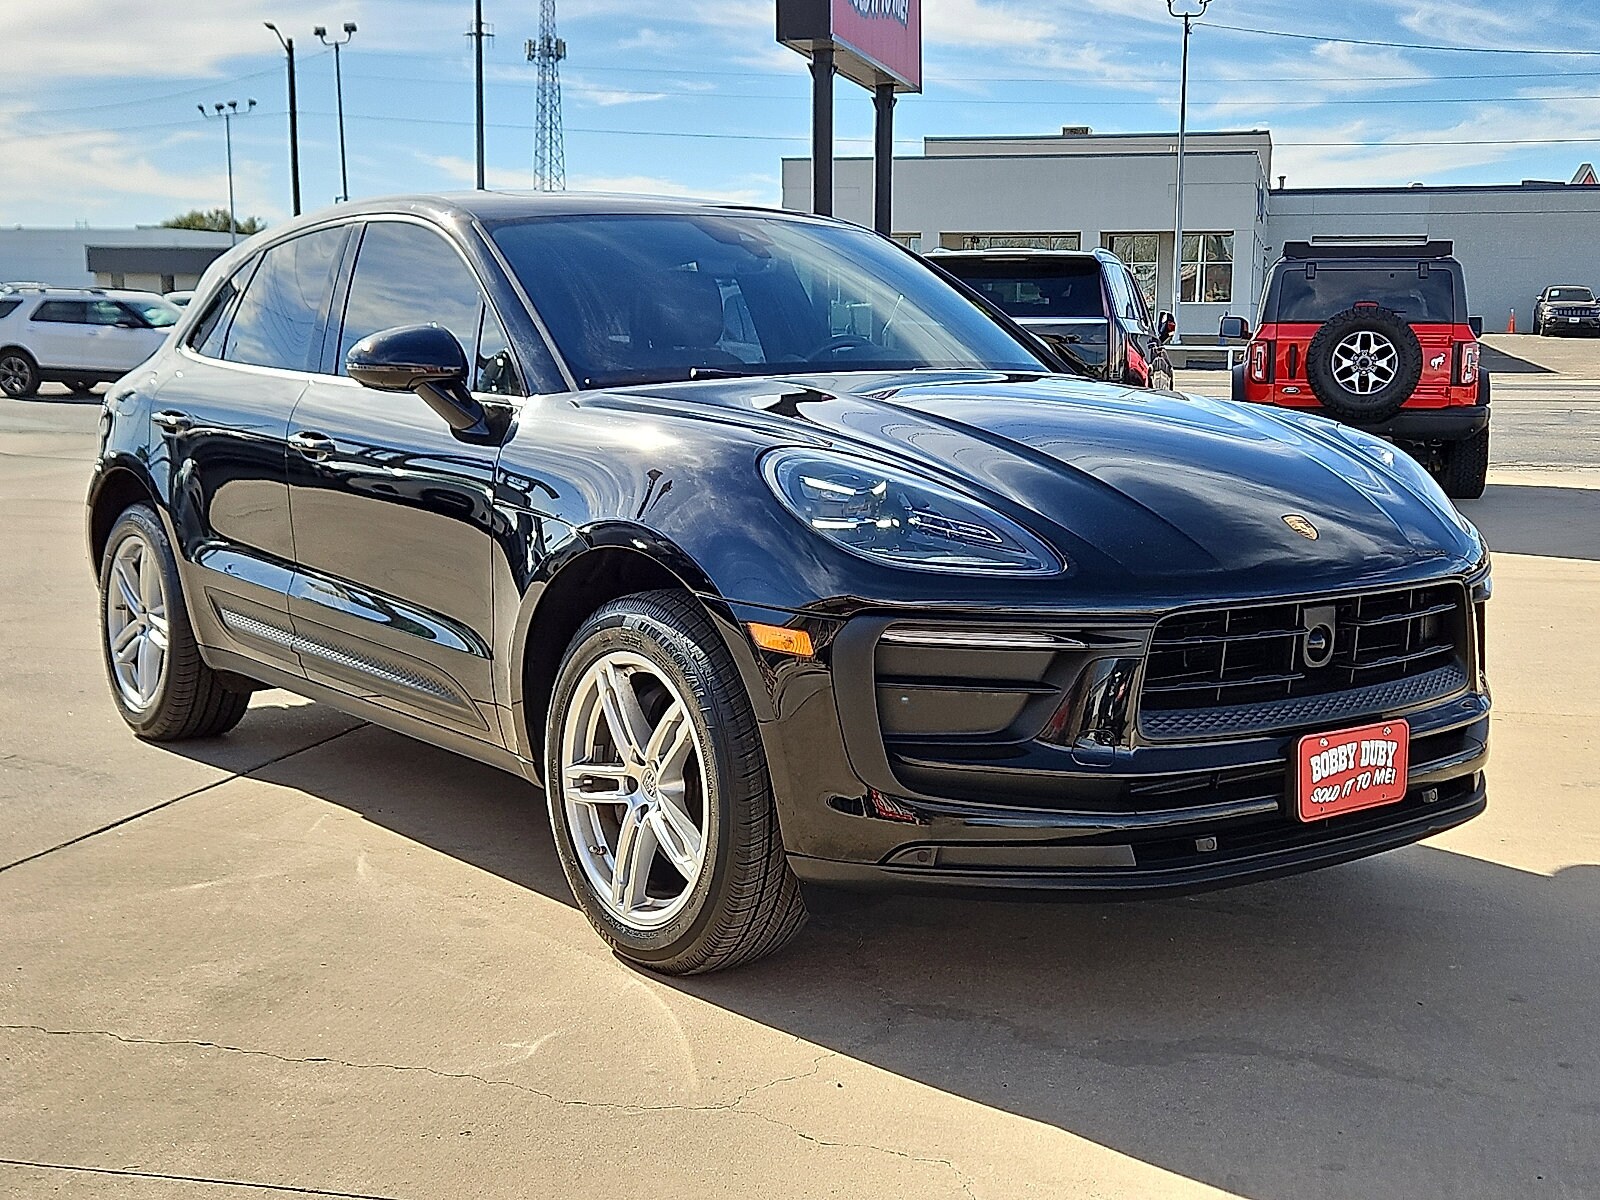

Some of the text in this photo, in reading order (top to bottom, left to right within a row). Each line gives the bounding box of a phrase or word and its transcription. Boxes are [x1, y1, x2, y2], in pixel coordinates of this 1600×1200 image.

[1310, 740, 1397, 783] BOBBY DUBY
[1311, 768, 1396, 803] SOLD IT TO ME!
